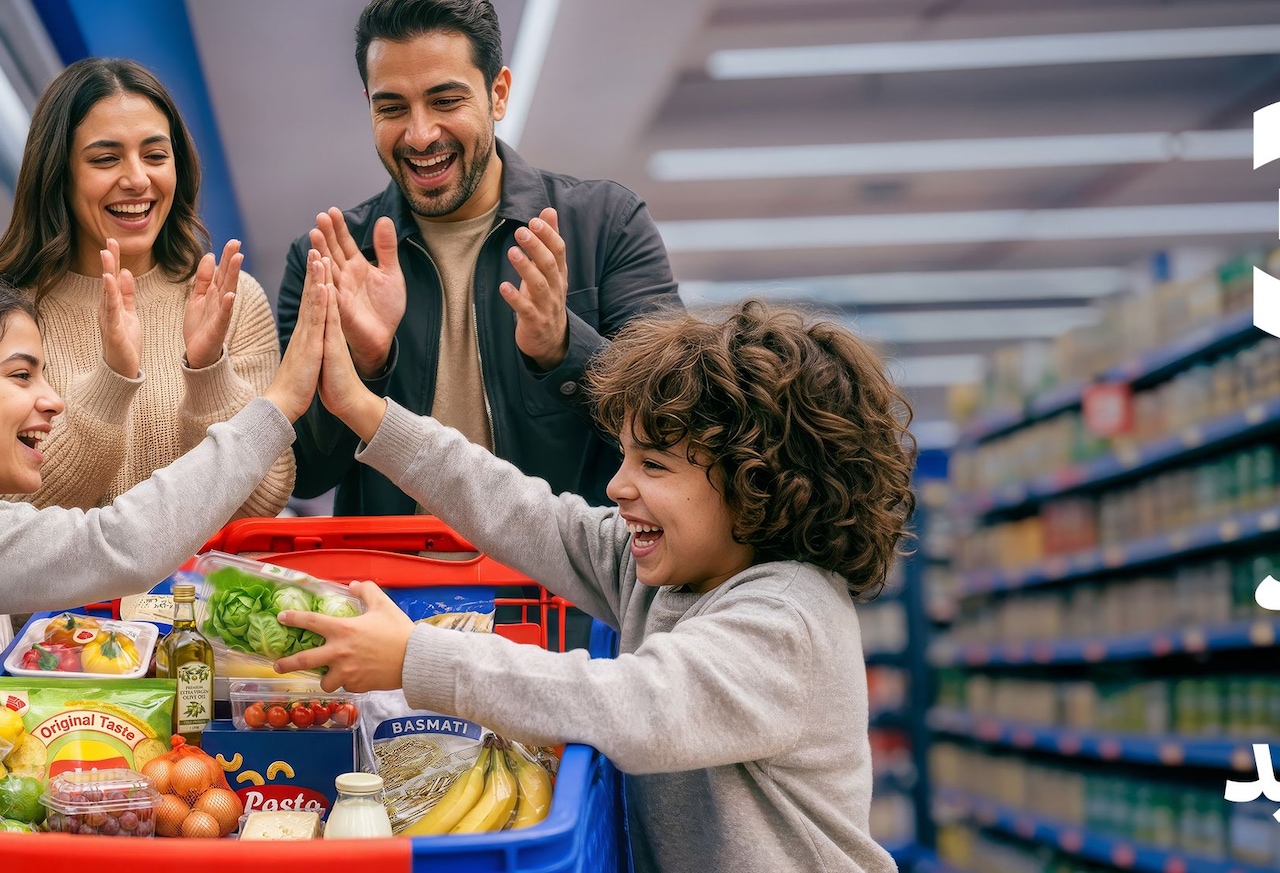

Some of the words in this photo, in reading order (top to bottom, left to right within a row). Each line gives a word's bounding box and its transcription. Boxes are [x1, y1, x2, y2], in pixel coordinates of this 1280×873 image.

[40, 713, 95, 740] Original
[99, 715, 136, 741] Taste
[391, 718, 469, 734] BASMATI
